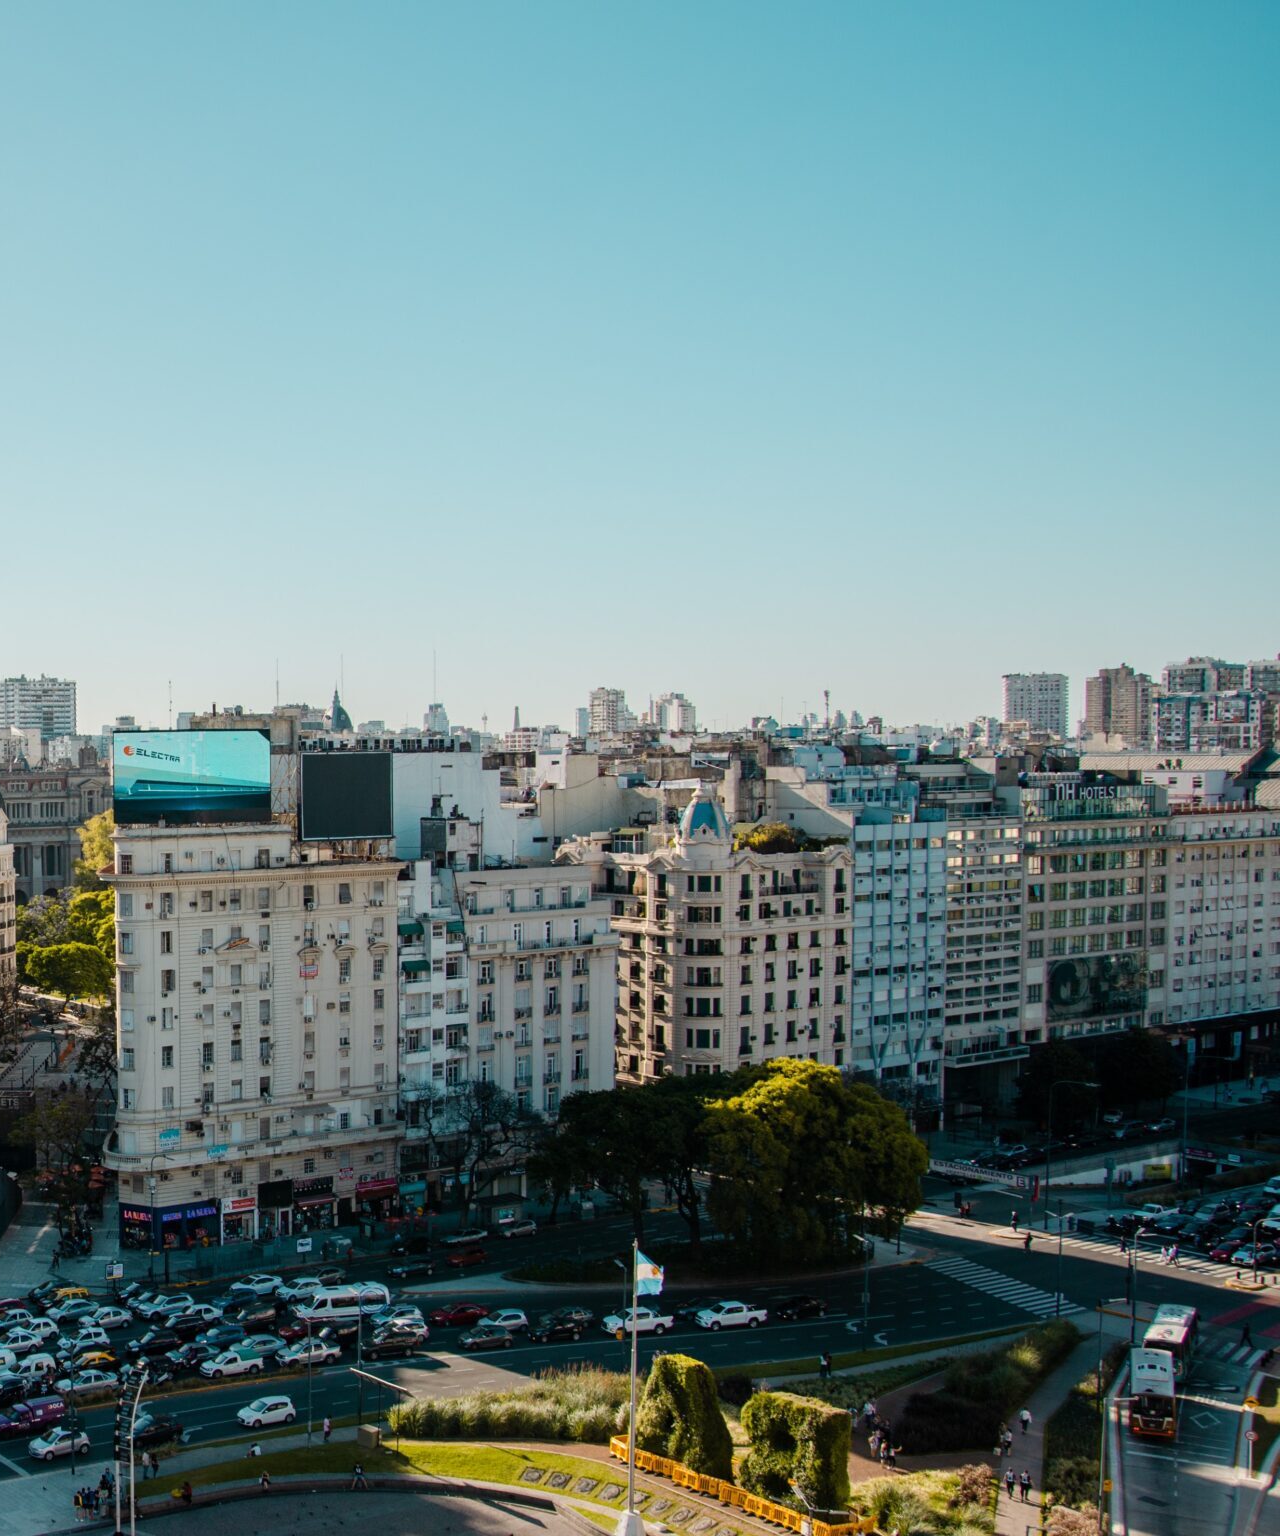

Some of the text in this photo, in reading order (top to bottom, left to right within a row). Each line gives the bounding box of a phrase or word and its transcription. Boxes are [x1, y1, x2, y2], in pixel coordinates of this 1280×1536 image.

[136, 748, 181, 762] ELECTRA
[1080, 786, 1115, 800] HOTELS
[933, 1160, 1013, 1180] ESTACIONAMIENTO
